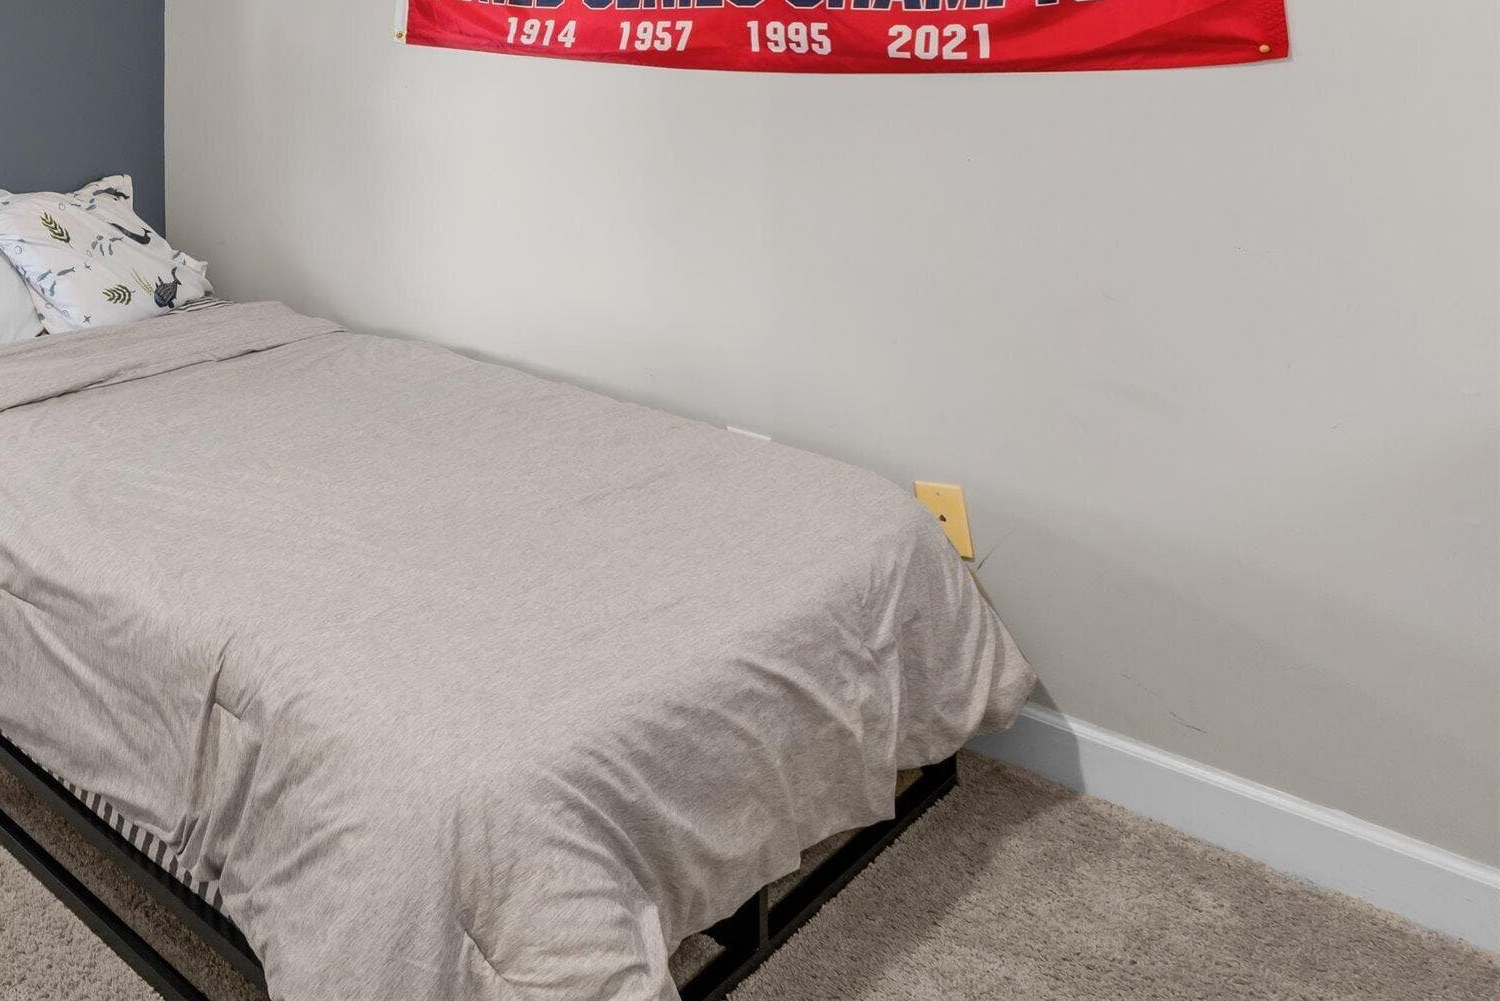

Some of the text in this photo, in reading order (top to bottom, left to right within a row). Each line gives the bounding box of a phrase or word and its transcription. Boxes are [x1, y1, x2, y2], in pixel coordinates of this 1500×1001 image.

[506, 16, 991, 60] 1914 1957 1995 2021
